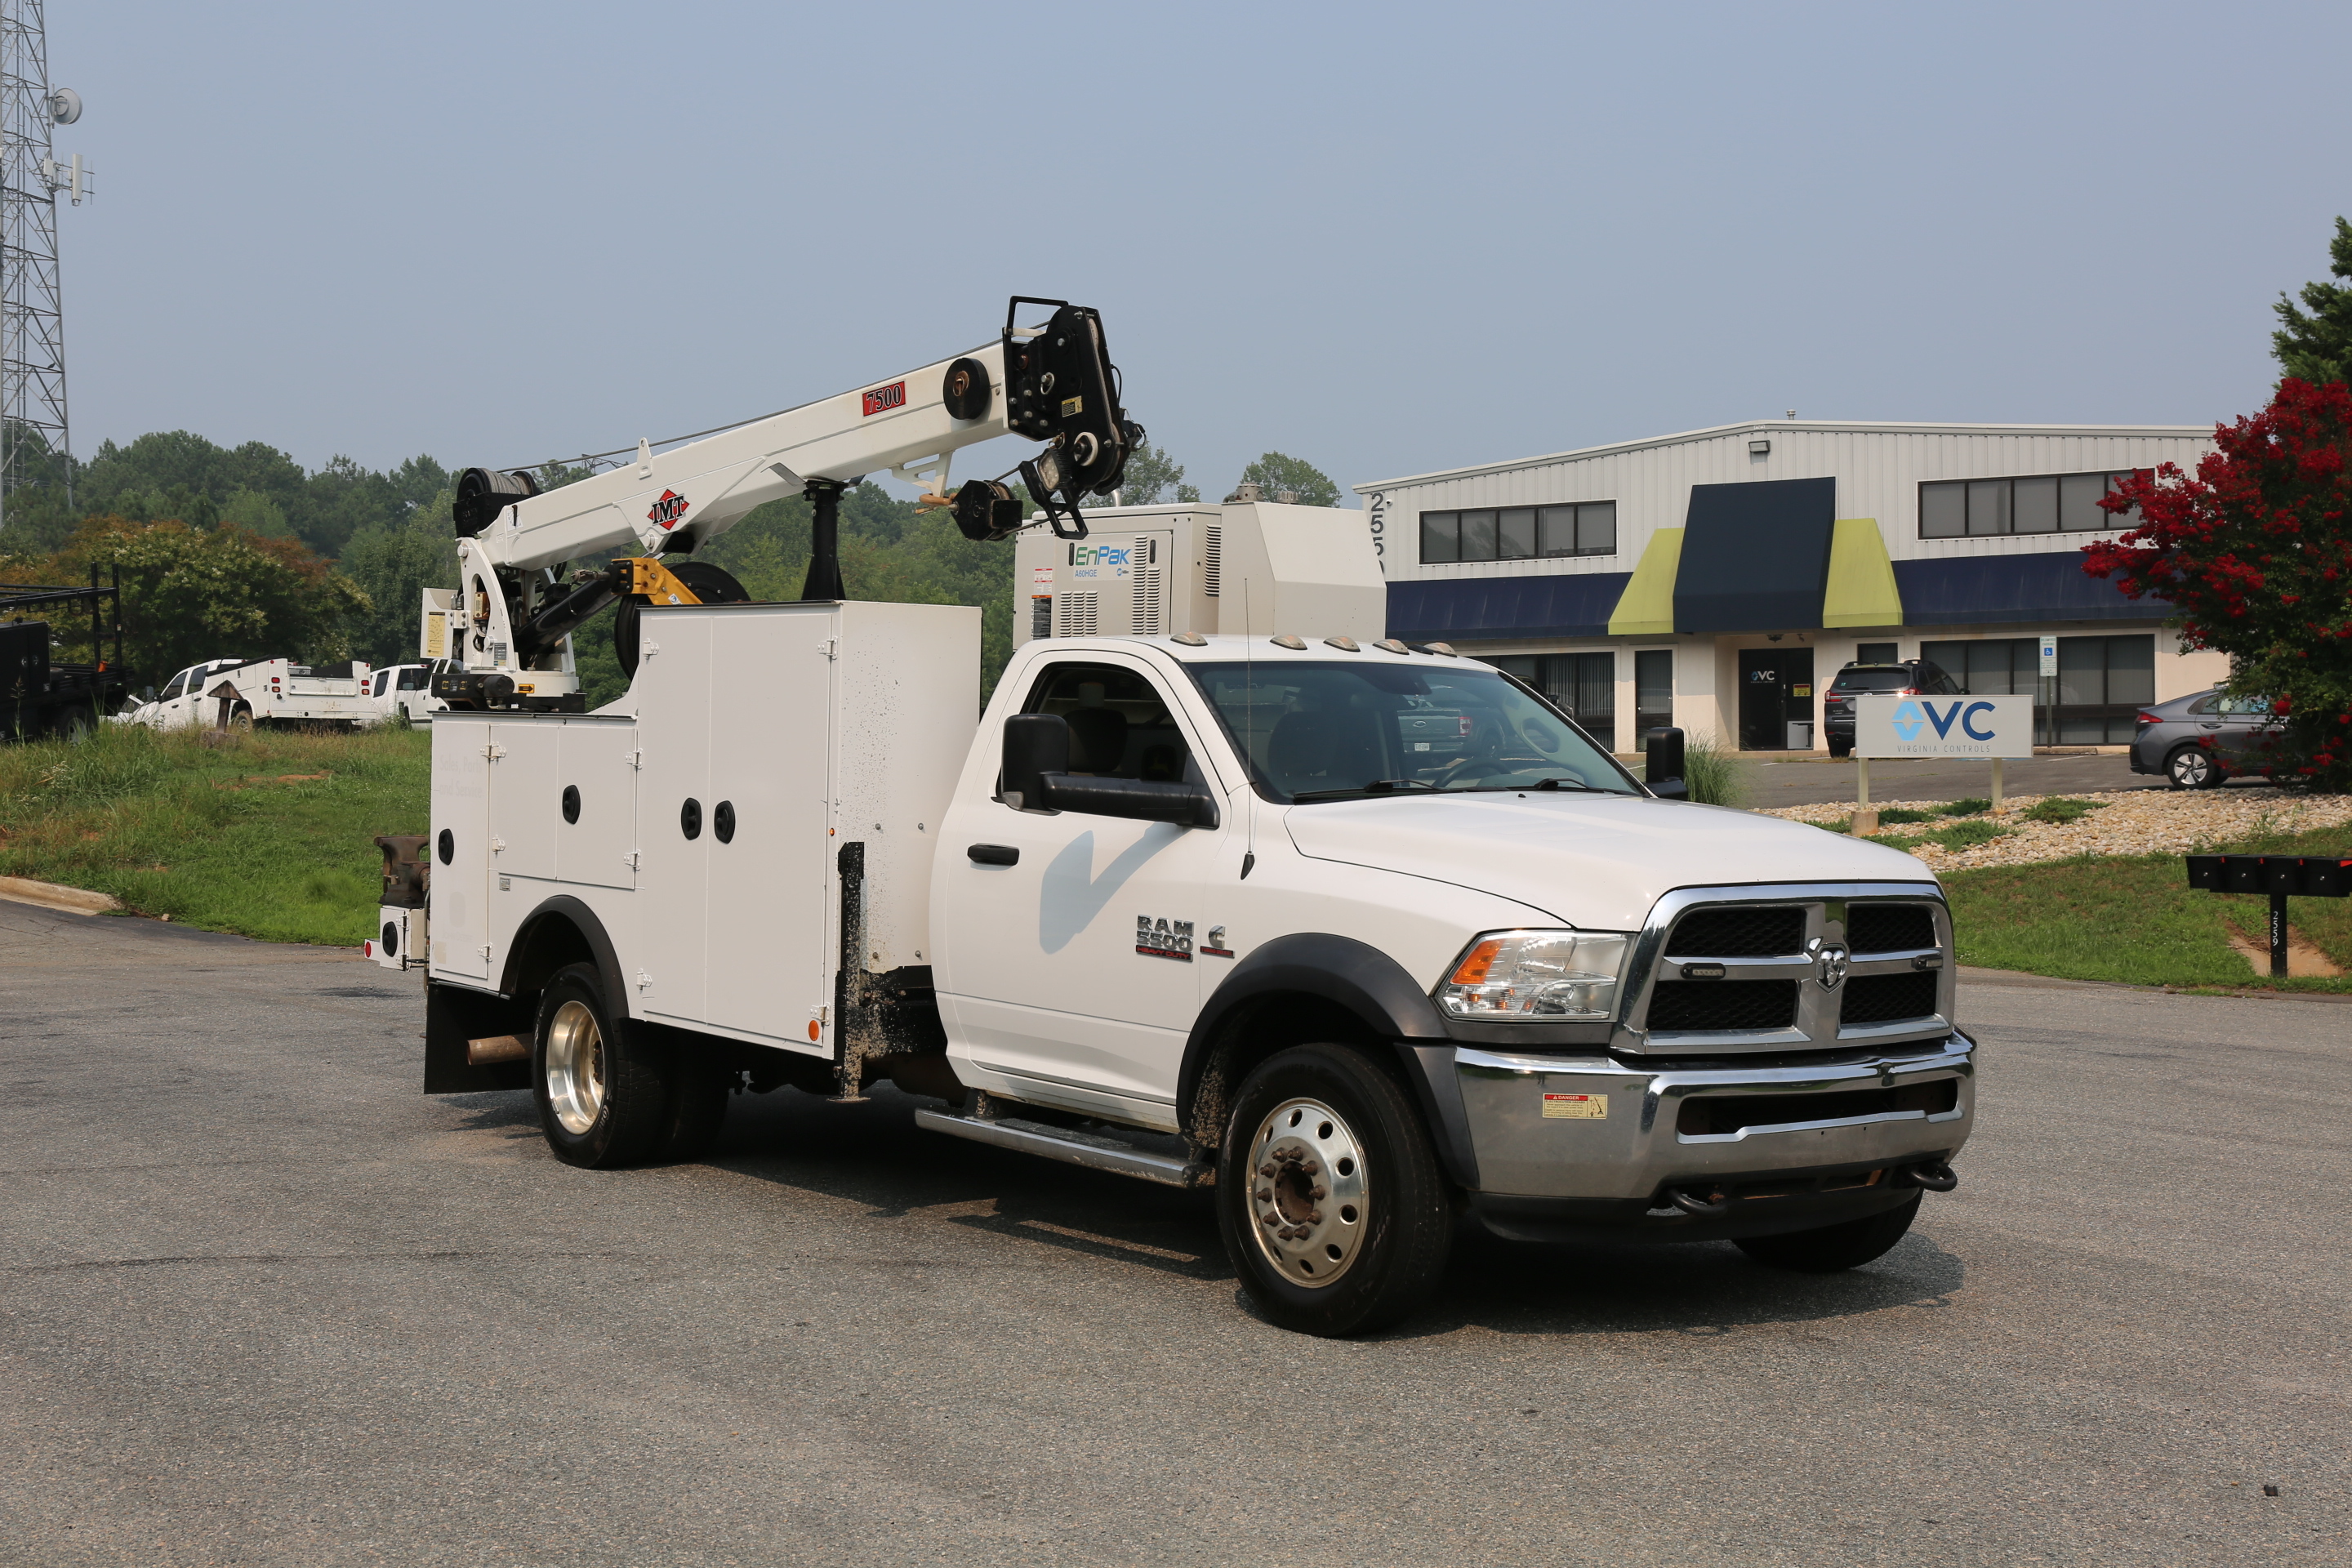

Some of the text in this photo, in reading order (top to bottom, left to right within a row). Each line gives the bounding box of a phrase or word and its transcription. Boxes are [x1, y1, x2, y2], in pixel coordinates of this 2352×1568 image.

[866, 384, 902, 413] 7500
[652, 494, 684, 525] IMT
[1370, 492, 1384, 575] 255
[1075, 546, 1133, 566] EnPak
[1075, 569, 1098, 577] A60HGE
[1921, 701, 1996, 742] VC
[1897, 745, 1990, 753] VIRGINIA CONTROLS
[463, 756, 483, 773] Parts
[439, 778, 483, 798] and Service
[1138, 915, 1194, 937] RAM
[1136, 930, 1194, 952] 5500
[1137, 947, 1190, 960] HEAVY DUTY
